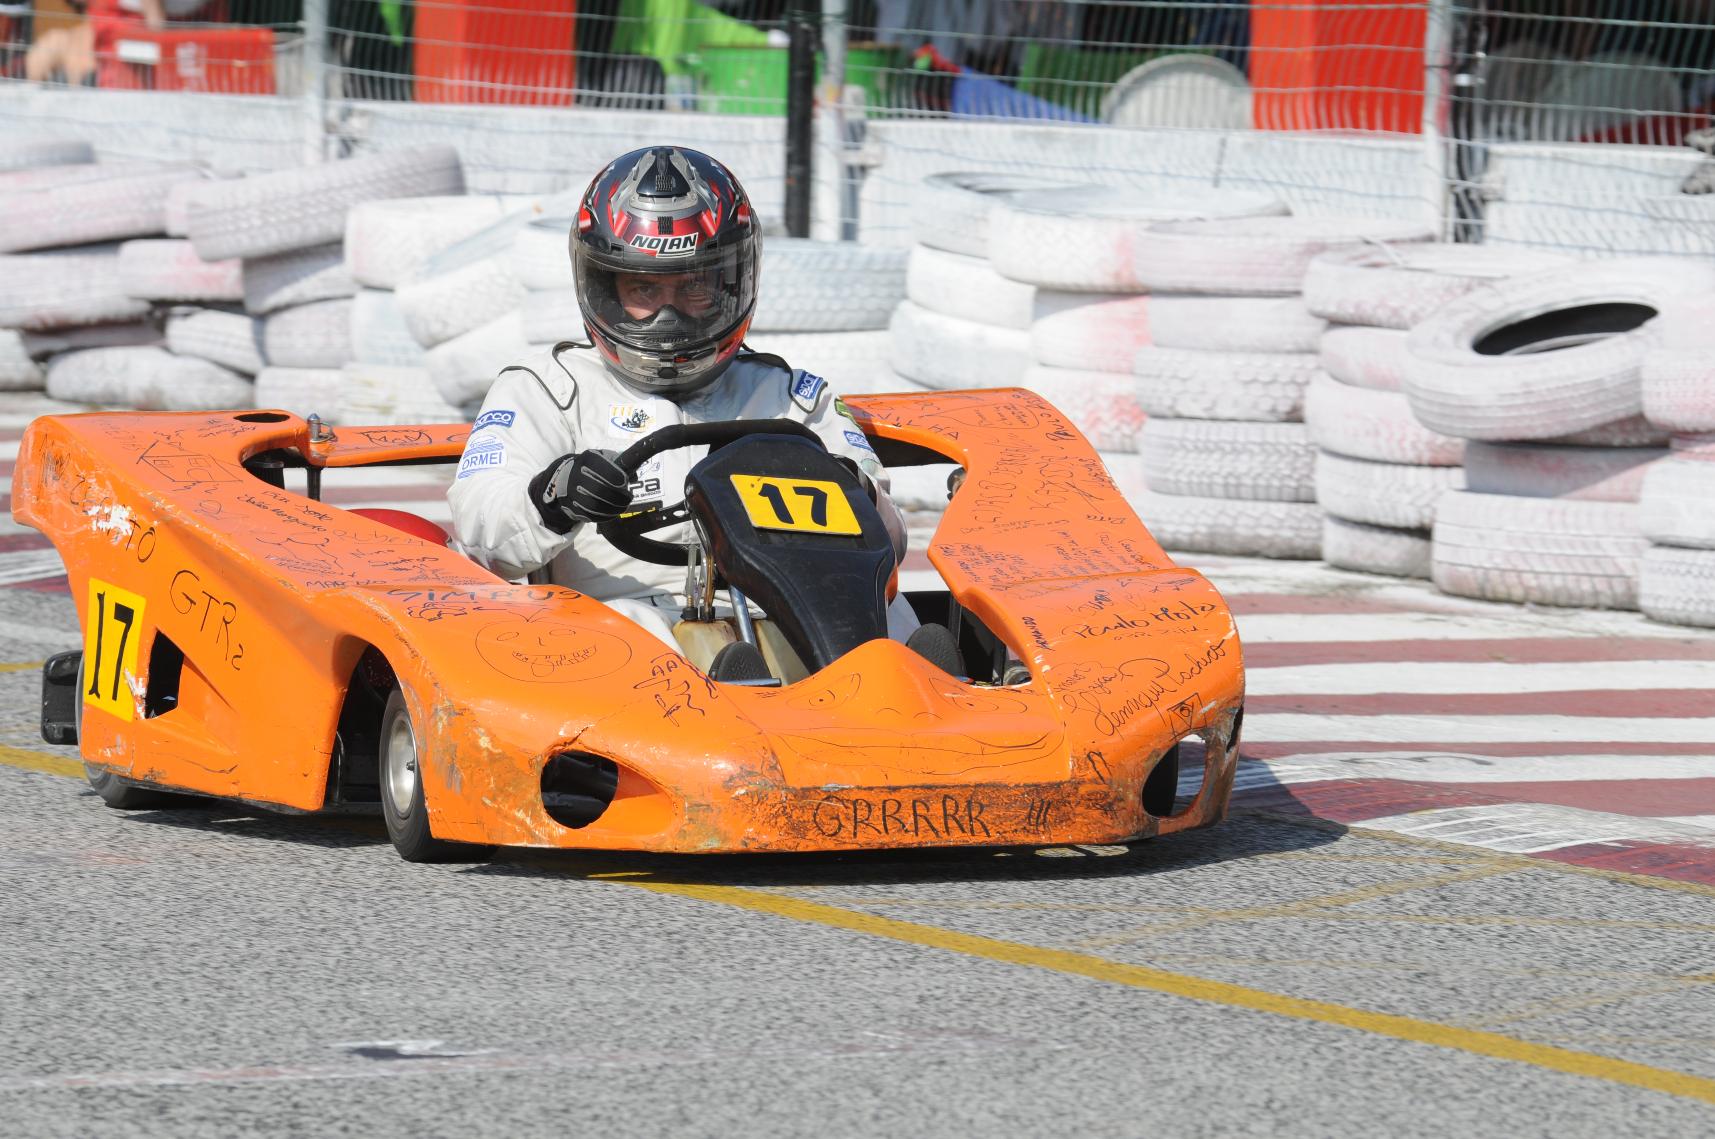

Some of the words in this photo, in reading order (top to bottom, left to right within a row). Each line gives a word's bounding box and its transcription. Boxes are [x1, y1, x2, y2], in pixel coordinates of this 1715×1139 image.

[631, 233, 698, 257] NOLAN
[758, 483, 828, 527] 17
[88, 591, 135, 702] 17
[812, 794, 991, 839] GRRRRR
